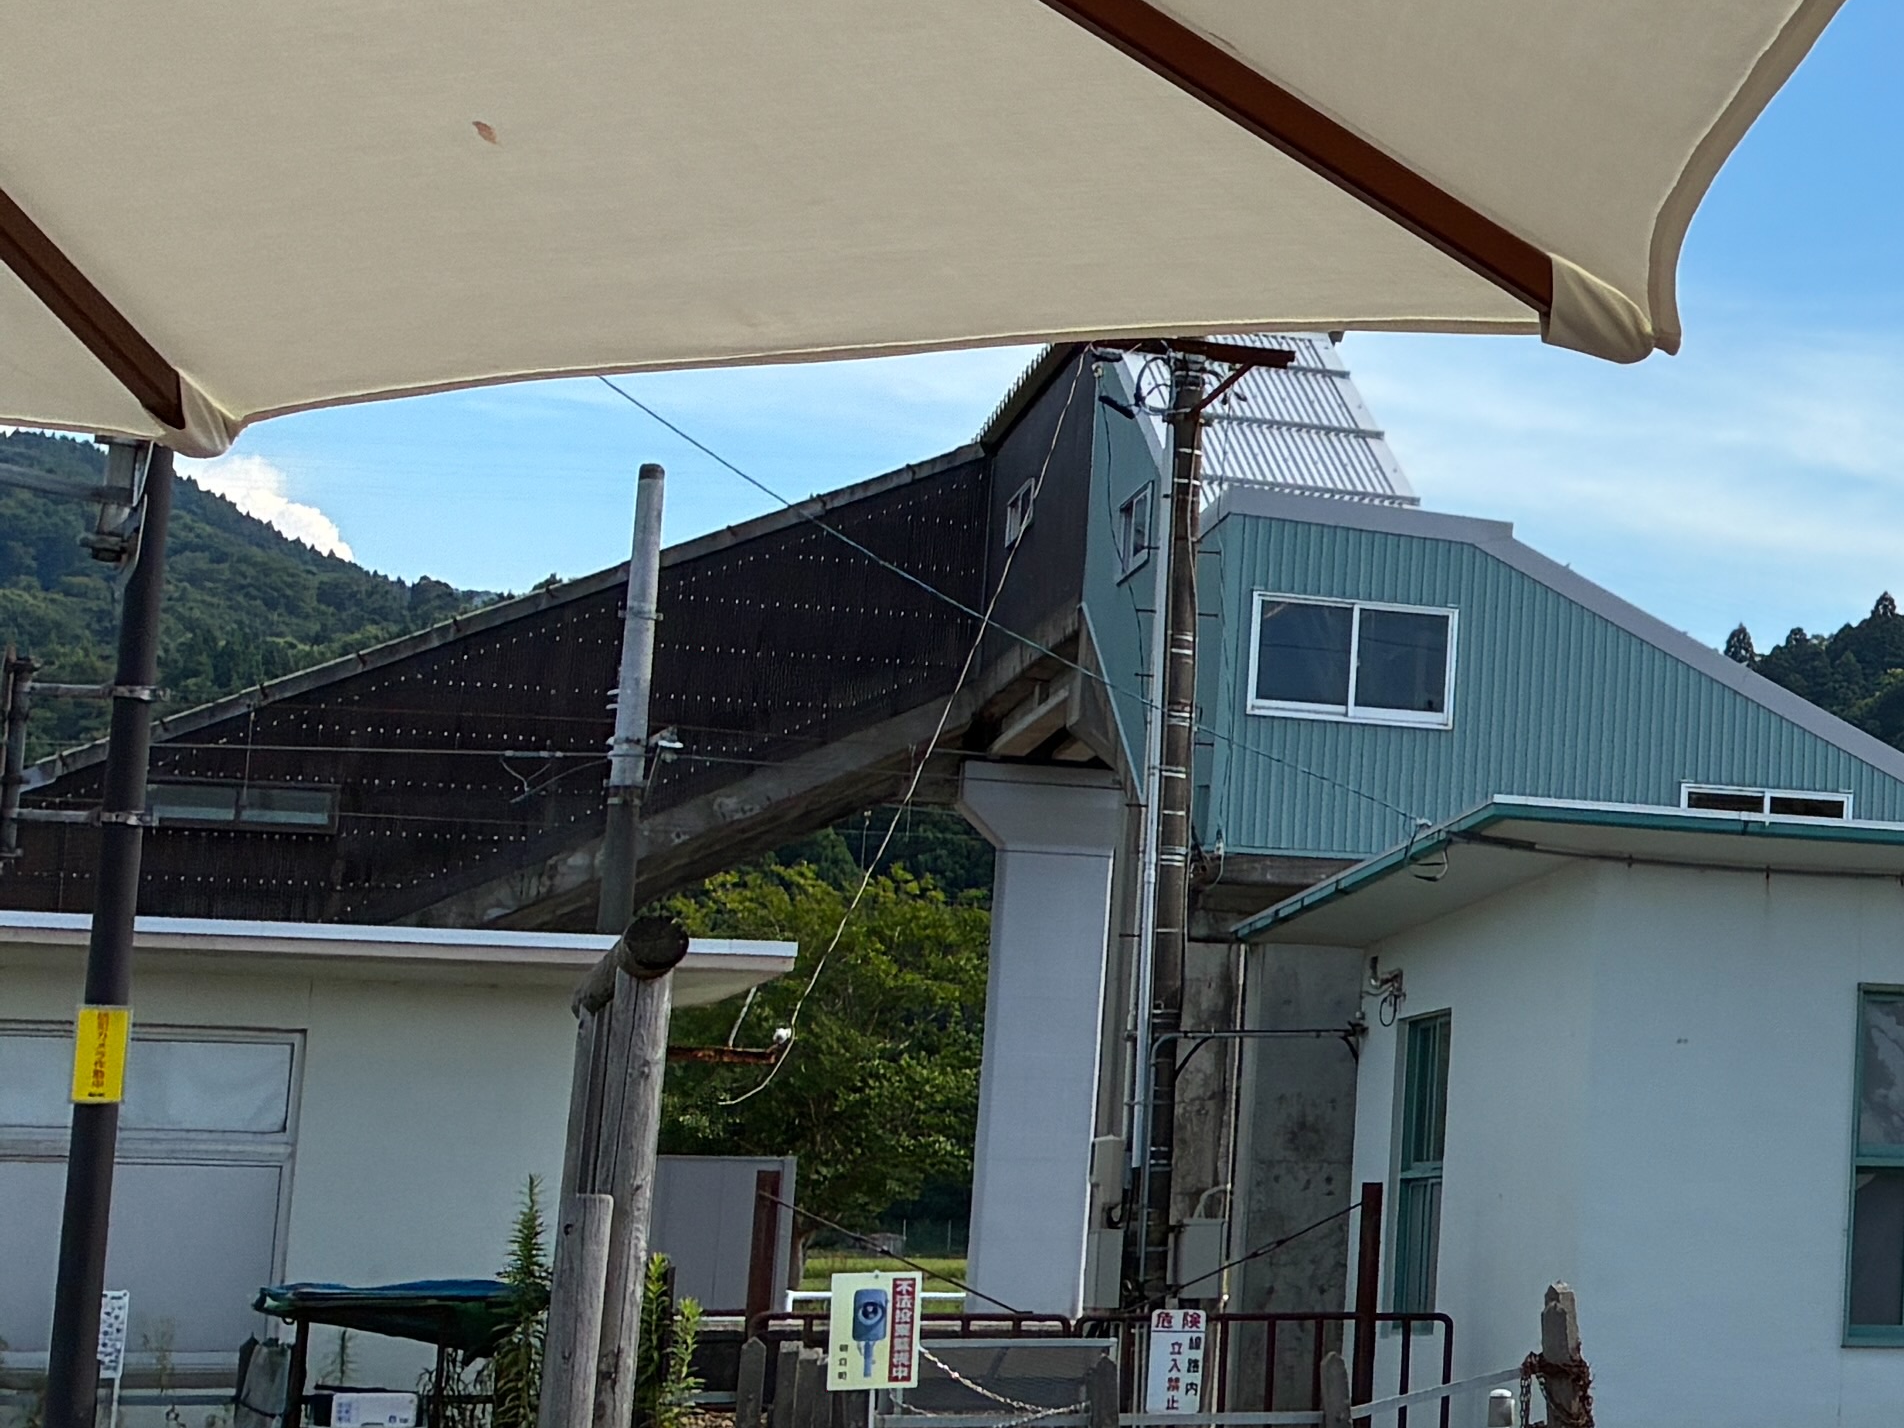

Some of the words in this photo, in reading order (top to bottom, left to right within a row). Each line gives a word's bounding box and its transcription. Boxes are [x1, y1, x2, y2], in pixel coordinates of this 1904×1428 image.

[1155, 1311, 1202, 1329] 危険
[1165, 1341, 1183, 1411] 立入禁止
